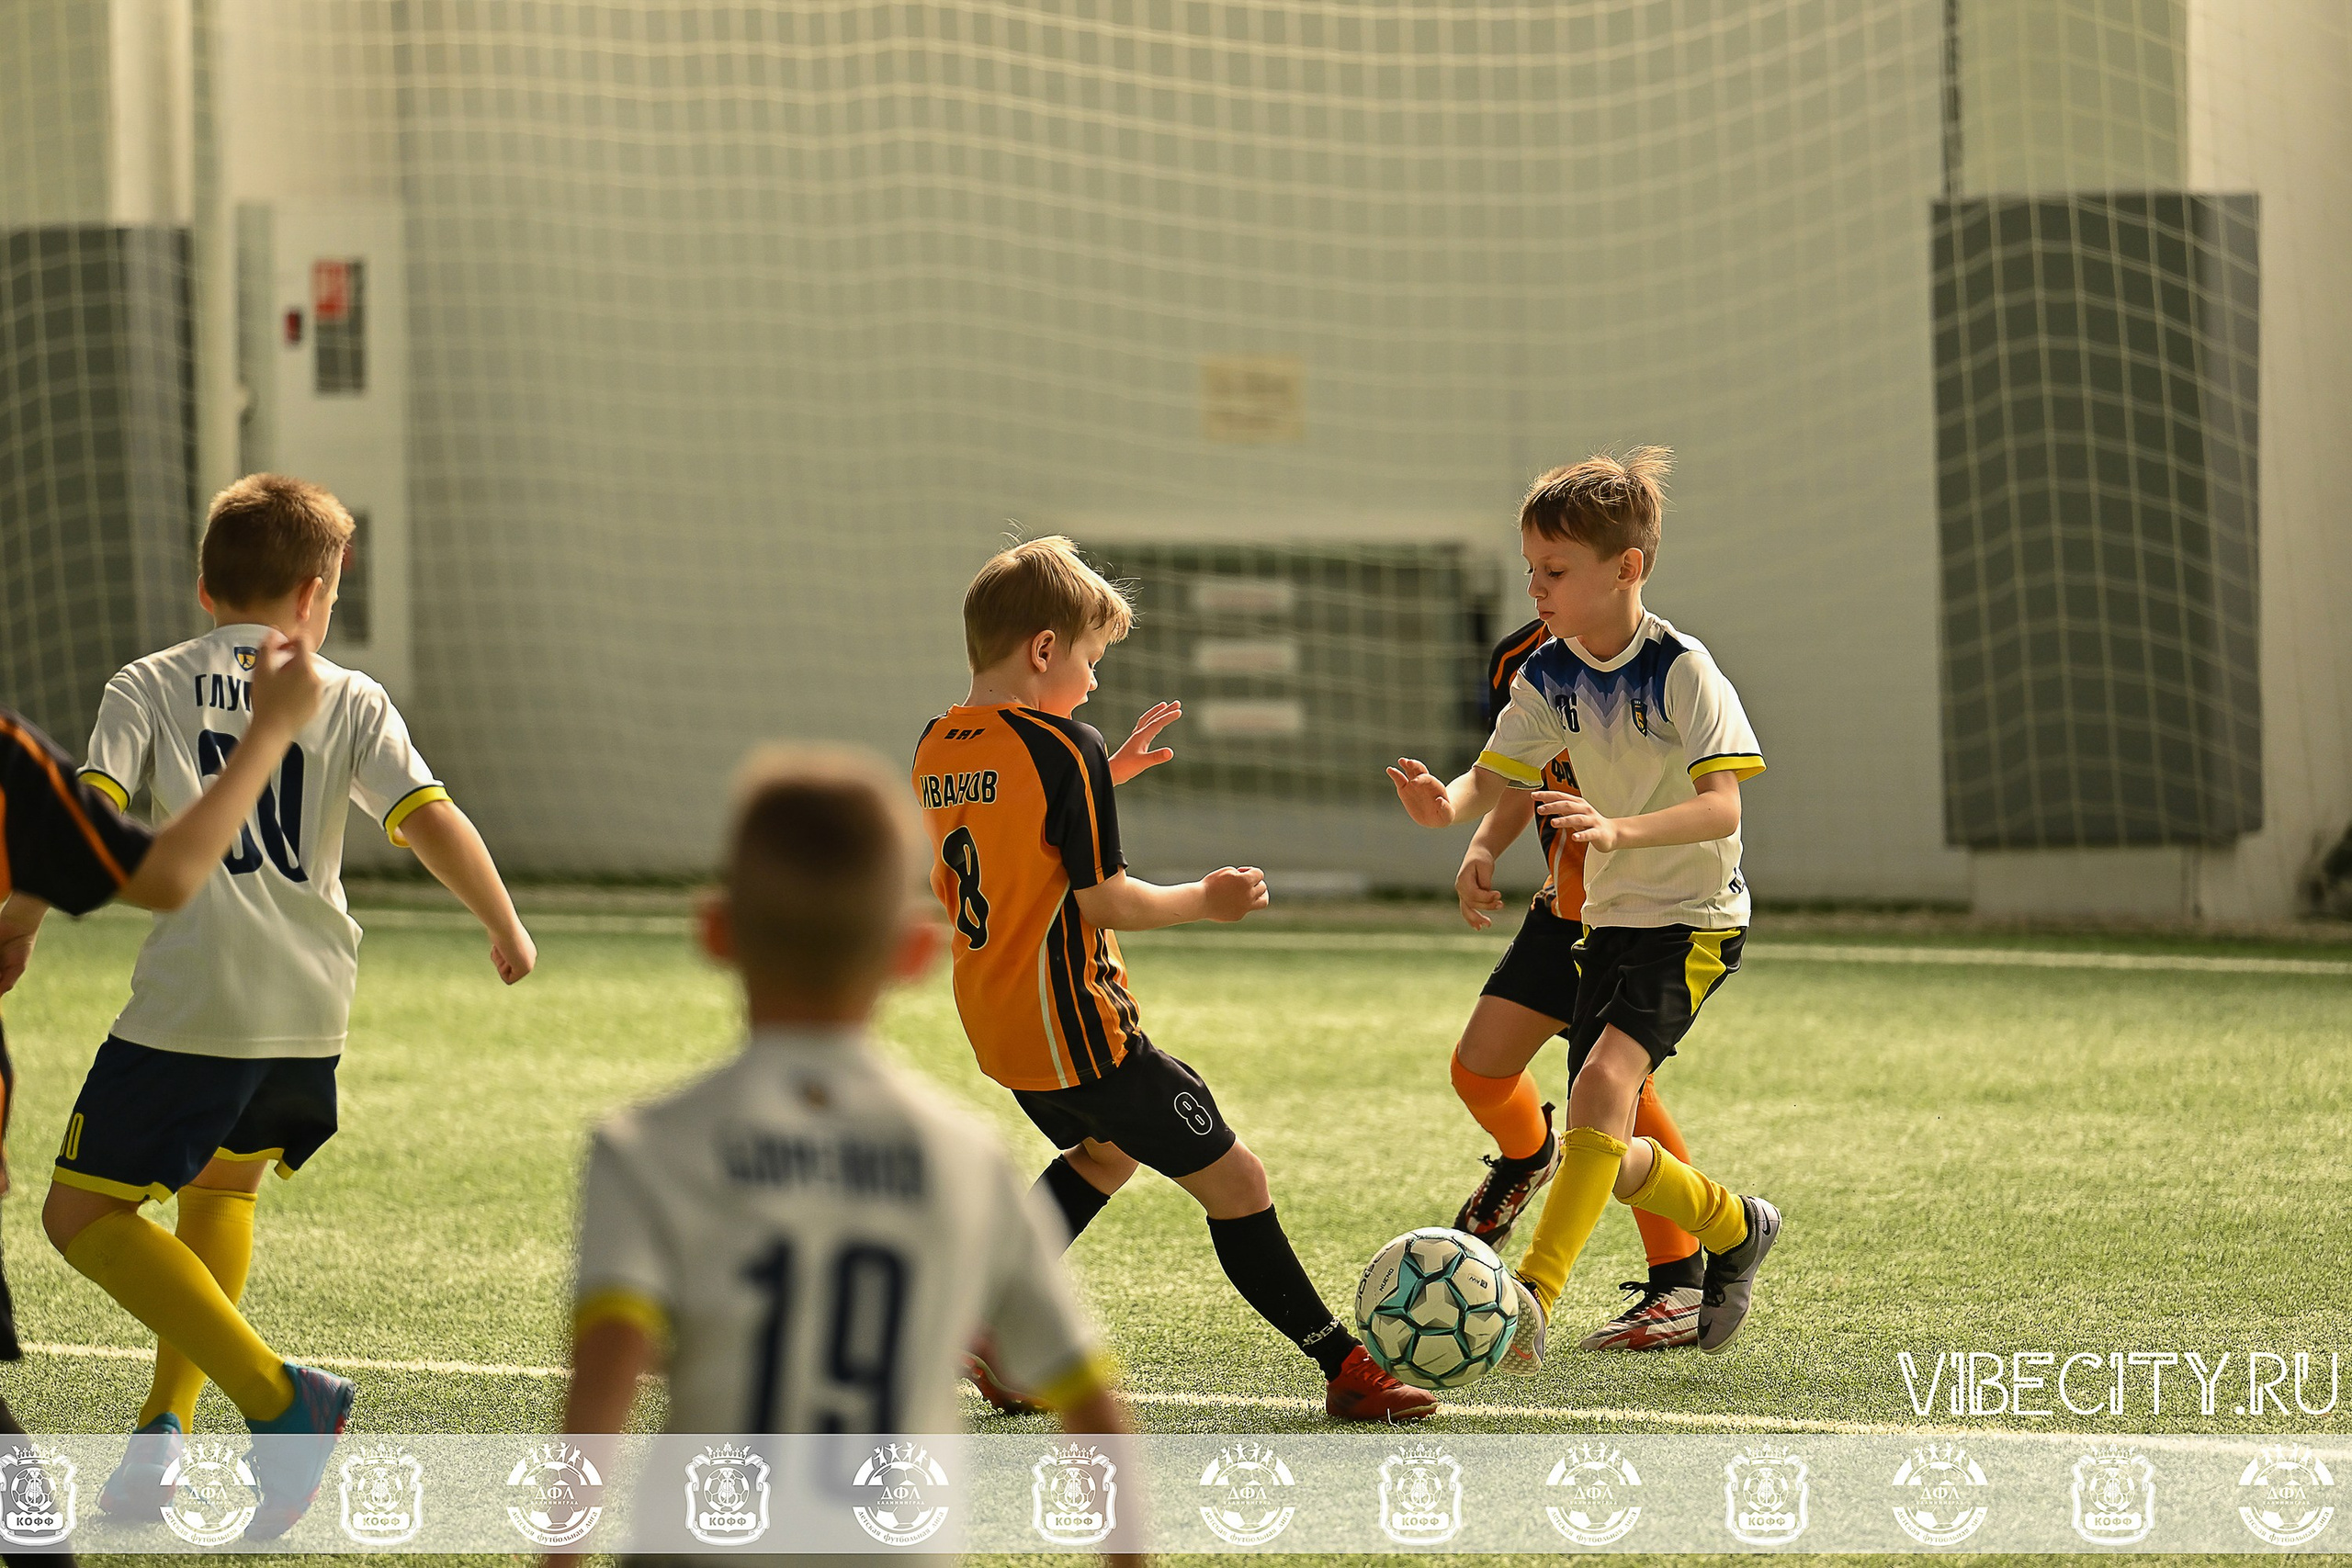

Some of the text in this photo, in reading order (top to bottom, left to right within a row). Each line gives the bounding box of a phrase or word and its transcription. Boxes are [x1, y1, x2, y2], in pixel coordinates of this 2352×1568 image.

[920, 770, 999, 809] ИВАНОВ
[942, 825, 990, 950] 8
[1173, 1091, 1213, 1135] 8
[1378, 1268, 1395, 1292] NUENO
[741, 1237, 908, 1506] 19
